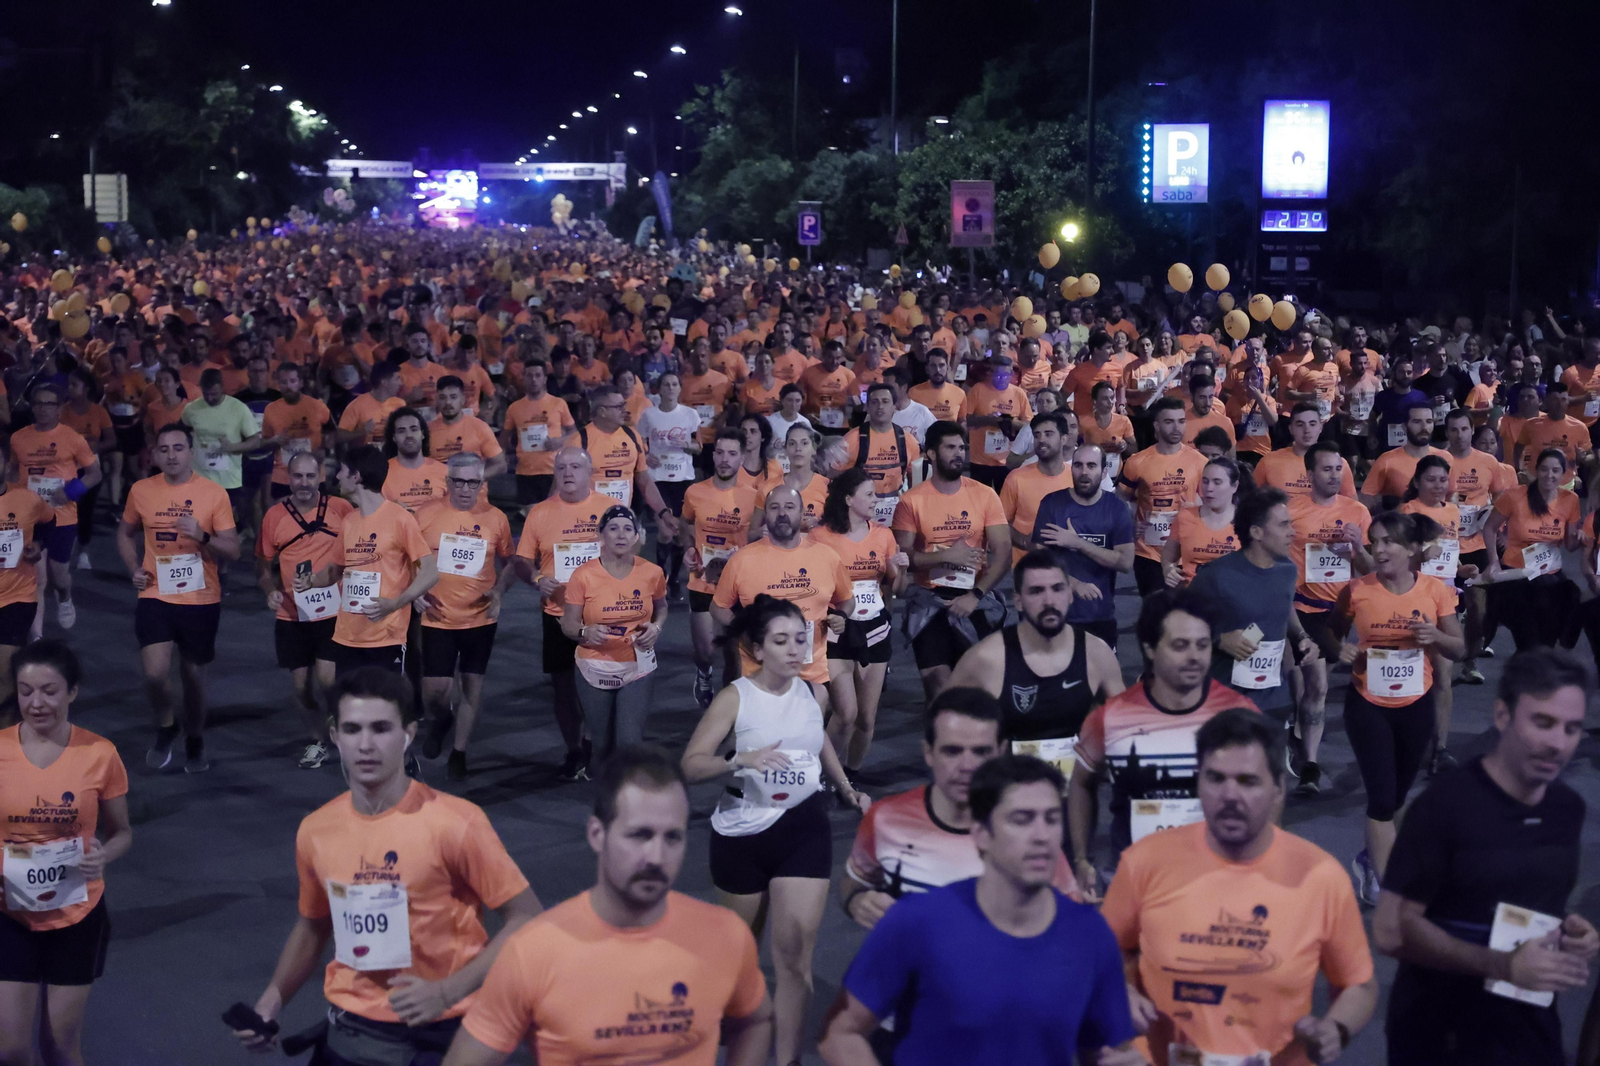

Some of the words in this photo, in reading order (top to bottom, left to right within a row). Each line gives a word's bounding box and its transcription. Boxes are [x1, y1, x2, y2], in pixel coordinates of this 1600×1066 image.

[1168, 131, 1199, 176] P
[1181, 166, 1198, 176] 24h
[1162, 188, 1193, 201] saba
[803, 216, 816, 231] P
[717, 513, 741, 521] NOCTURNA
[875, 507, 892, 516] 9432
[455, 531, 482, 539] NOCTURNA
[0, 543, 12, 553] 61
[452, 548, 475, 561] 6585
[1319, 556, 1342, 566] 9722
[1534, 550, 1552, 563] 3883
[170, 566, 193, 579] 2570
[347, 584, 370, 597] 11086
[305, 590, 332, 605] 14214
[1248, 656, 1277, 670] 10241
[1380, 665, 1414, 678] 10239
[599, 679, 621, 687] PUMA
[764, 769, 806, 786] 11536
[29, 808, 79, 816] NOCTURNA
[8, 815, 51, 823] SEVILLA
[27, 864, 66, 884] 6002
[343, 910, 389, 935] 11609
[1179, 932, 1234, 947] SEVILLA
[627, 1009, 695, 1022] NOCTURNA
[594, 1024, 657, 1040] SEVILLA
